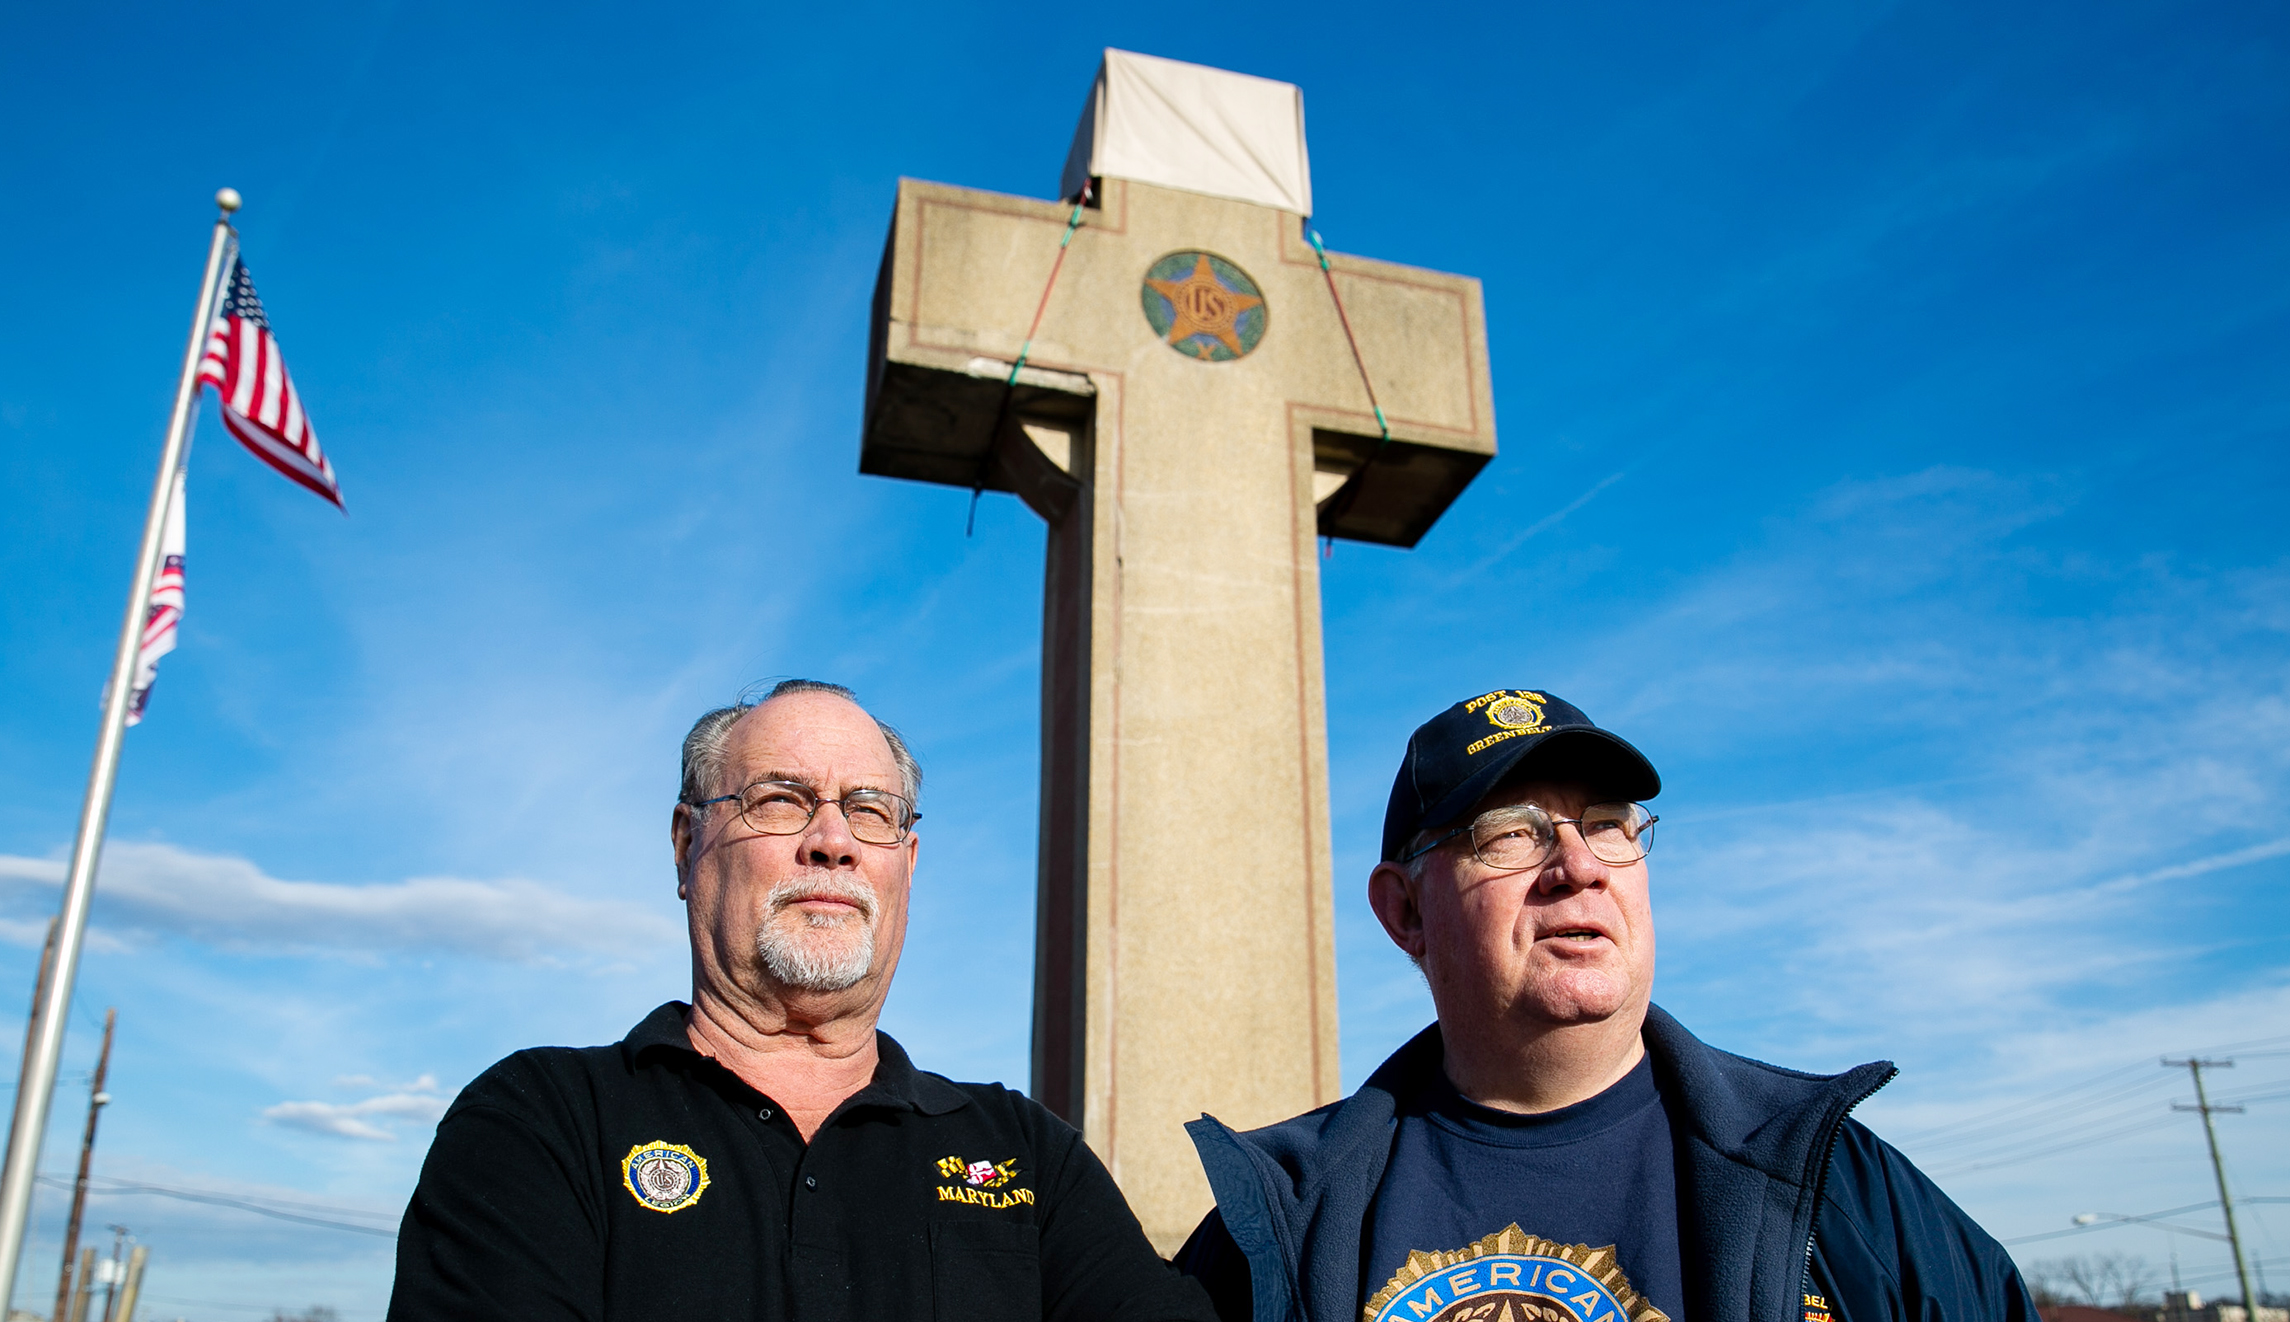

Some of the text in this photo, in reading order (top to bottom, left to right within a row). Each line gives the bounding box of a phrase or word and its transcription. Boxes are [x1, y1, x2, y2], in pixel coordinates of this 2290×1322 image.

[1465, 690, 1506, 714] POST
[1466, 725, 1553, 755] GREENBELT
[631, 1149, 696, 1169] AMERICAN
[656, 1174, 673, 1187] US
[936, 1186, 1035, 1209] MARYLAND
